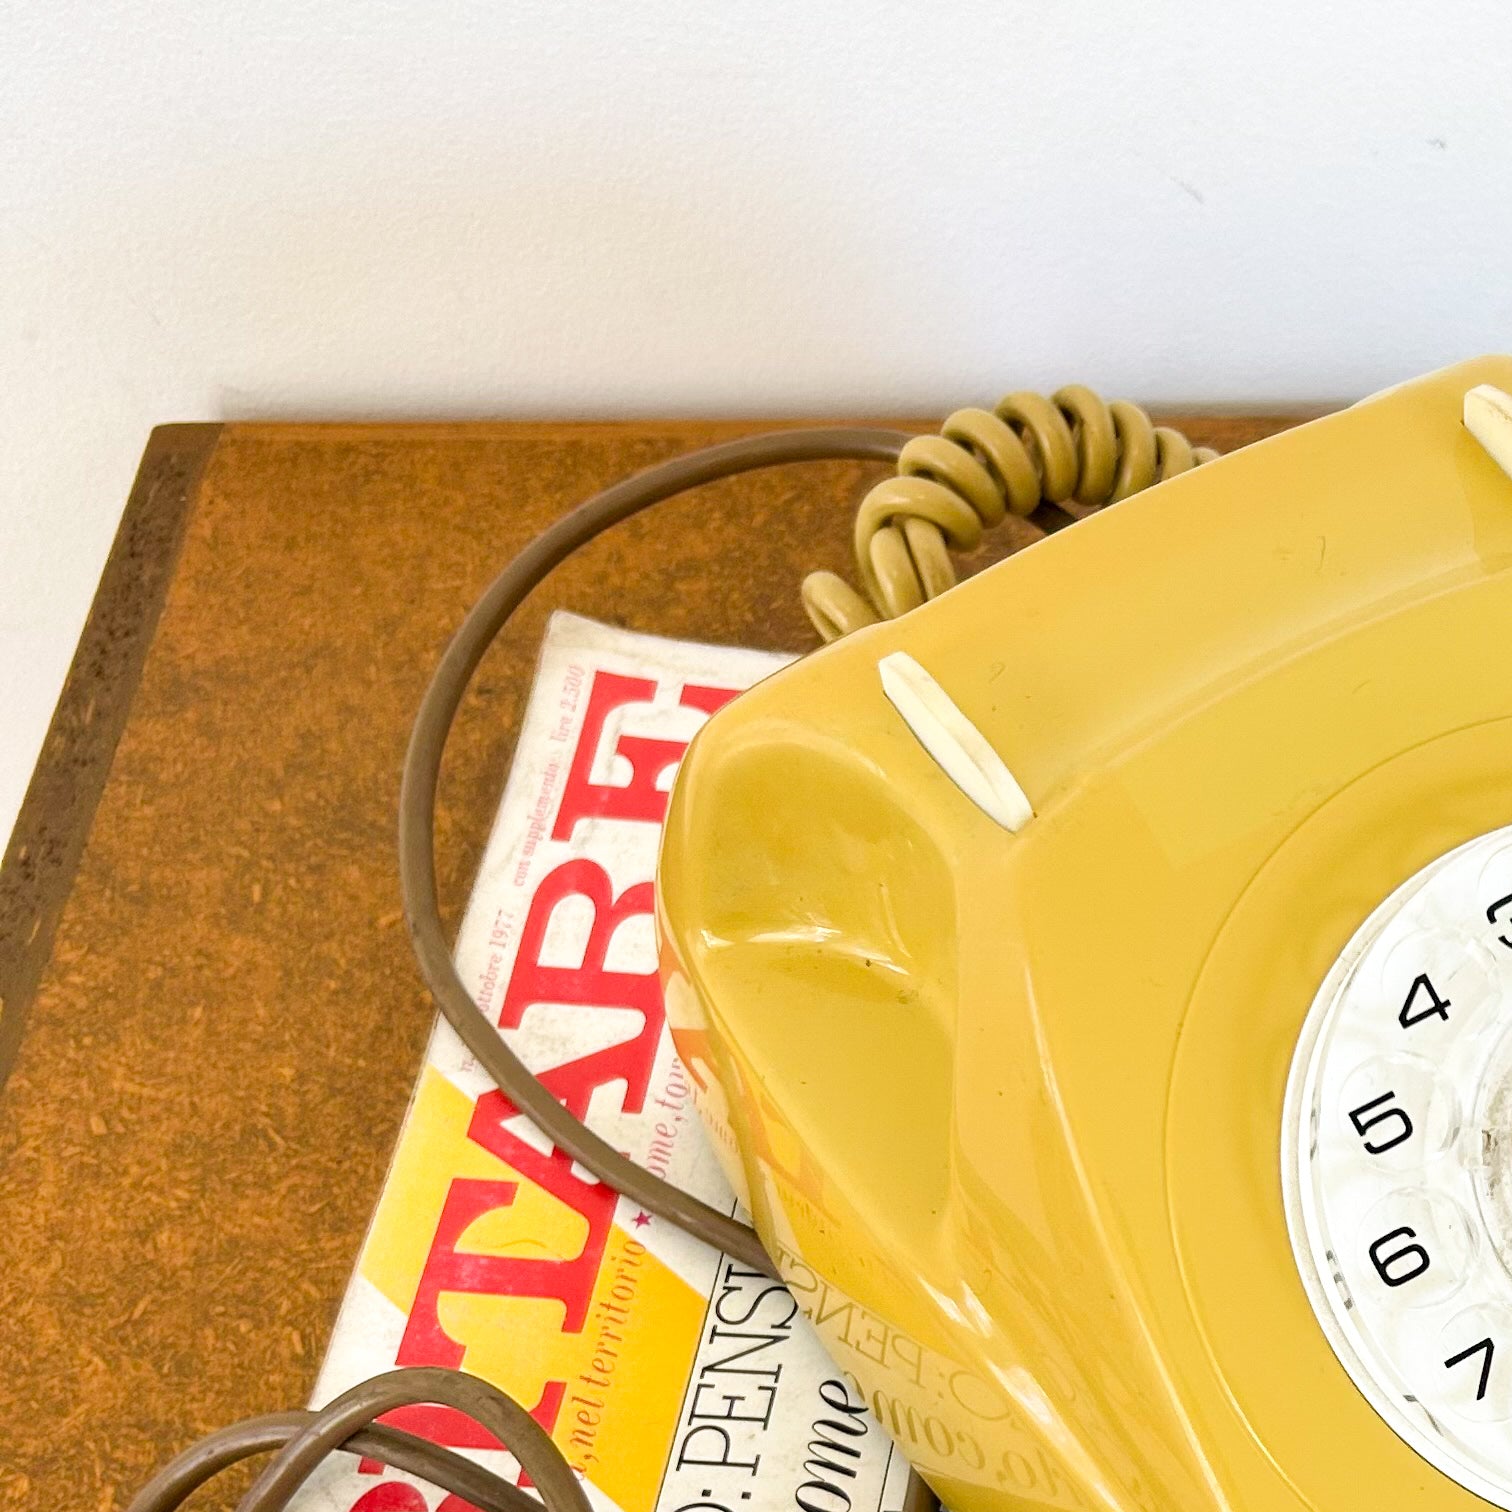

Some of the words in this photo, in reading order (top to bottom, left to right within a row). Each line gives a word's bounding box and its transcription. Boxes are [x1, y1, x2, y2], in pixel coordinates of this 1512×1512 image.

[1398, 974, 1451, 1030] 4
[1349, 1091, 1412, 1154] 5
[1369, 1227, 1431, 1287] 6
[588, 1241, 647, 1390] territorio
[1445, 1338, 1494, 1401] 7
